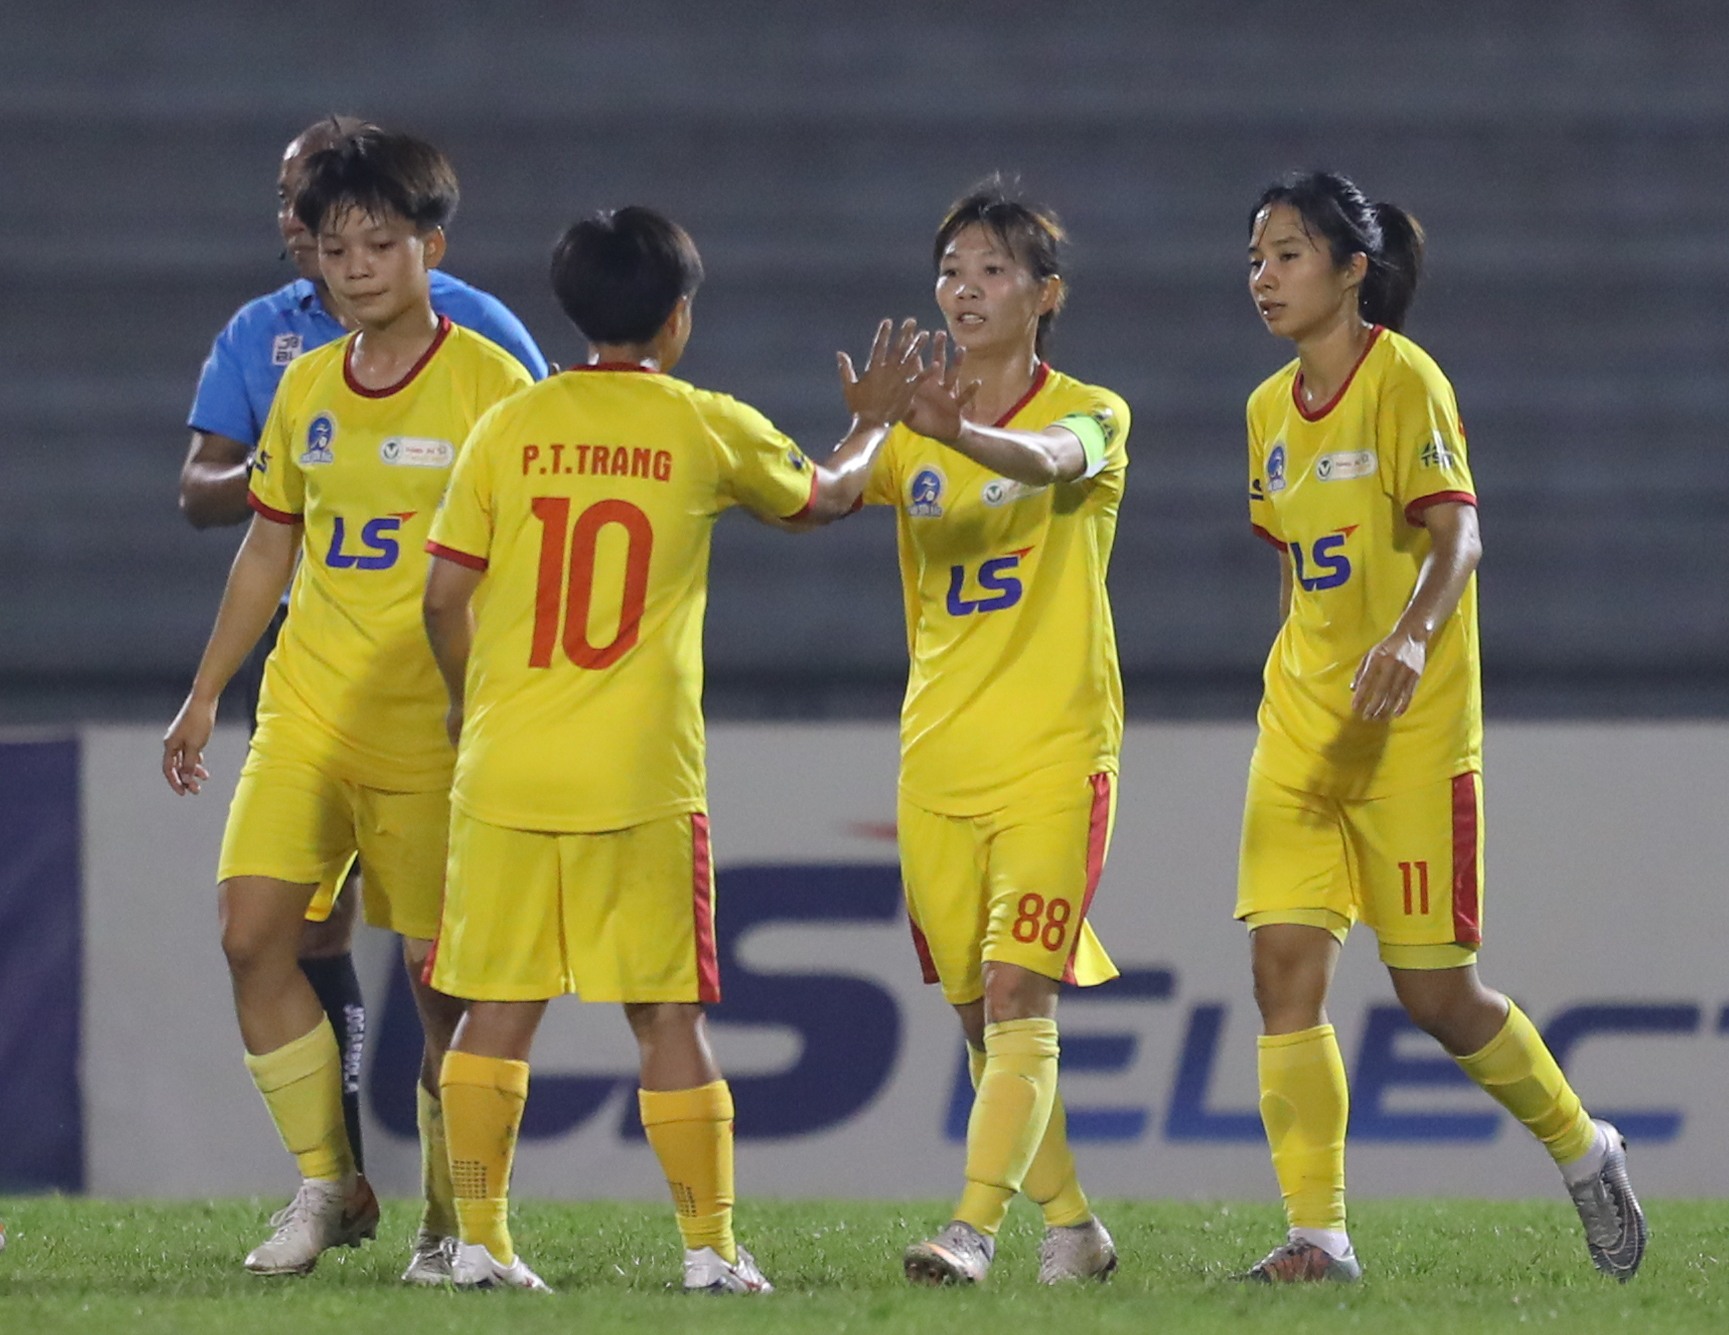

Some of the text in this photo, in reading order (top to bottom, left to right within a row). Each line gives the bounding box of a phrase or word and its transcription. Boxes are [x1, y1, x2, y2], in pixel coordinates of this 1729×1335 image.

[522, 443, 673, 482] P.T.TRANG
[325, 516, 400, 570] LS
[1290, 534, 1352, 592] LS
[528, 496, 653, 671] 10
[946, 555, 1023, 617] LS
[1398, 861, 1429, 915] 11
[1012, 892, 1071, 952] 88
[944, 966, 1729, 1144] ELEC
